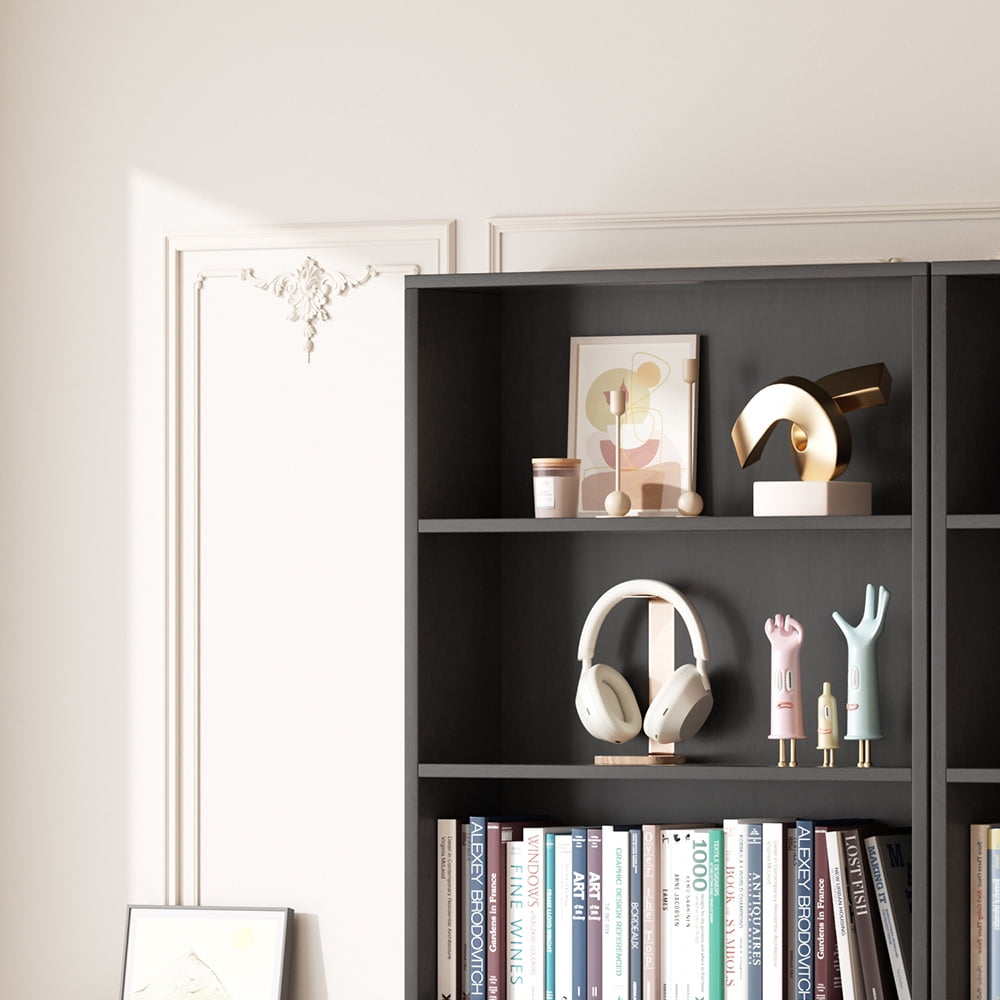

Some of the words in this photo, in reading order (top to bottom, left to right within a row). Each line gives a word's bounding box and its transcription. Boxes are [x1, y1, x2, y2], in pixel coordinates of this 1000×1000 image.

[470, 821, 484, 886] ALEXEY
[527, 834, 539, 908] WINDOWS
[692, 839, 708, 892] 1000
[797, 825, 811, 891] ALEXEY
[844, 834, 861, 877] LOST
[489, 873, 497, 904] France
[510, 864, 523, 909] FINE
[573, 871, 585, 900] ART
[588, 871, 600, 900] ART
[725, 866, 736, 904] BOOK
[816, 878, 825, 910] France
[835, 883, 843, 906] URBAN
[867, 845, 884, 891] MAKING
[878, 892, 887, 904] IT
[489, 905, 497, 914] in
[816, 911, 825, 921] in
[851, 878, 868, 916] FISH
[489, 915, 497, 953] Gardens
[631, 902, 639, 949] BORDEAUX
[752, 872, 761, 966] ANTIQUAIRES
[837, 907, 846, 936] HOUSING
[470, 889, 484, 996] BRODOVITCH
[510, 918, 523, 985] WINES
[725, 919, 736, 987] SYMBOLS
[816, 922, 825, 960] Gardens
